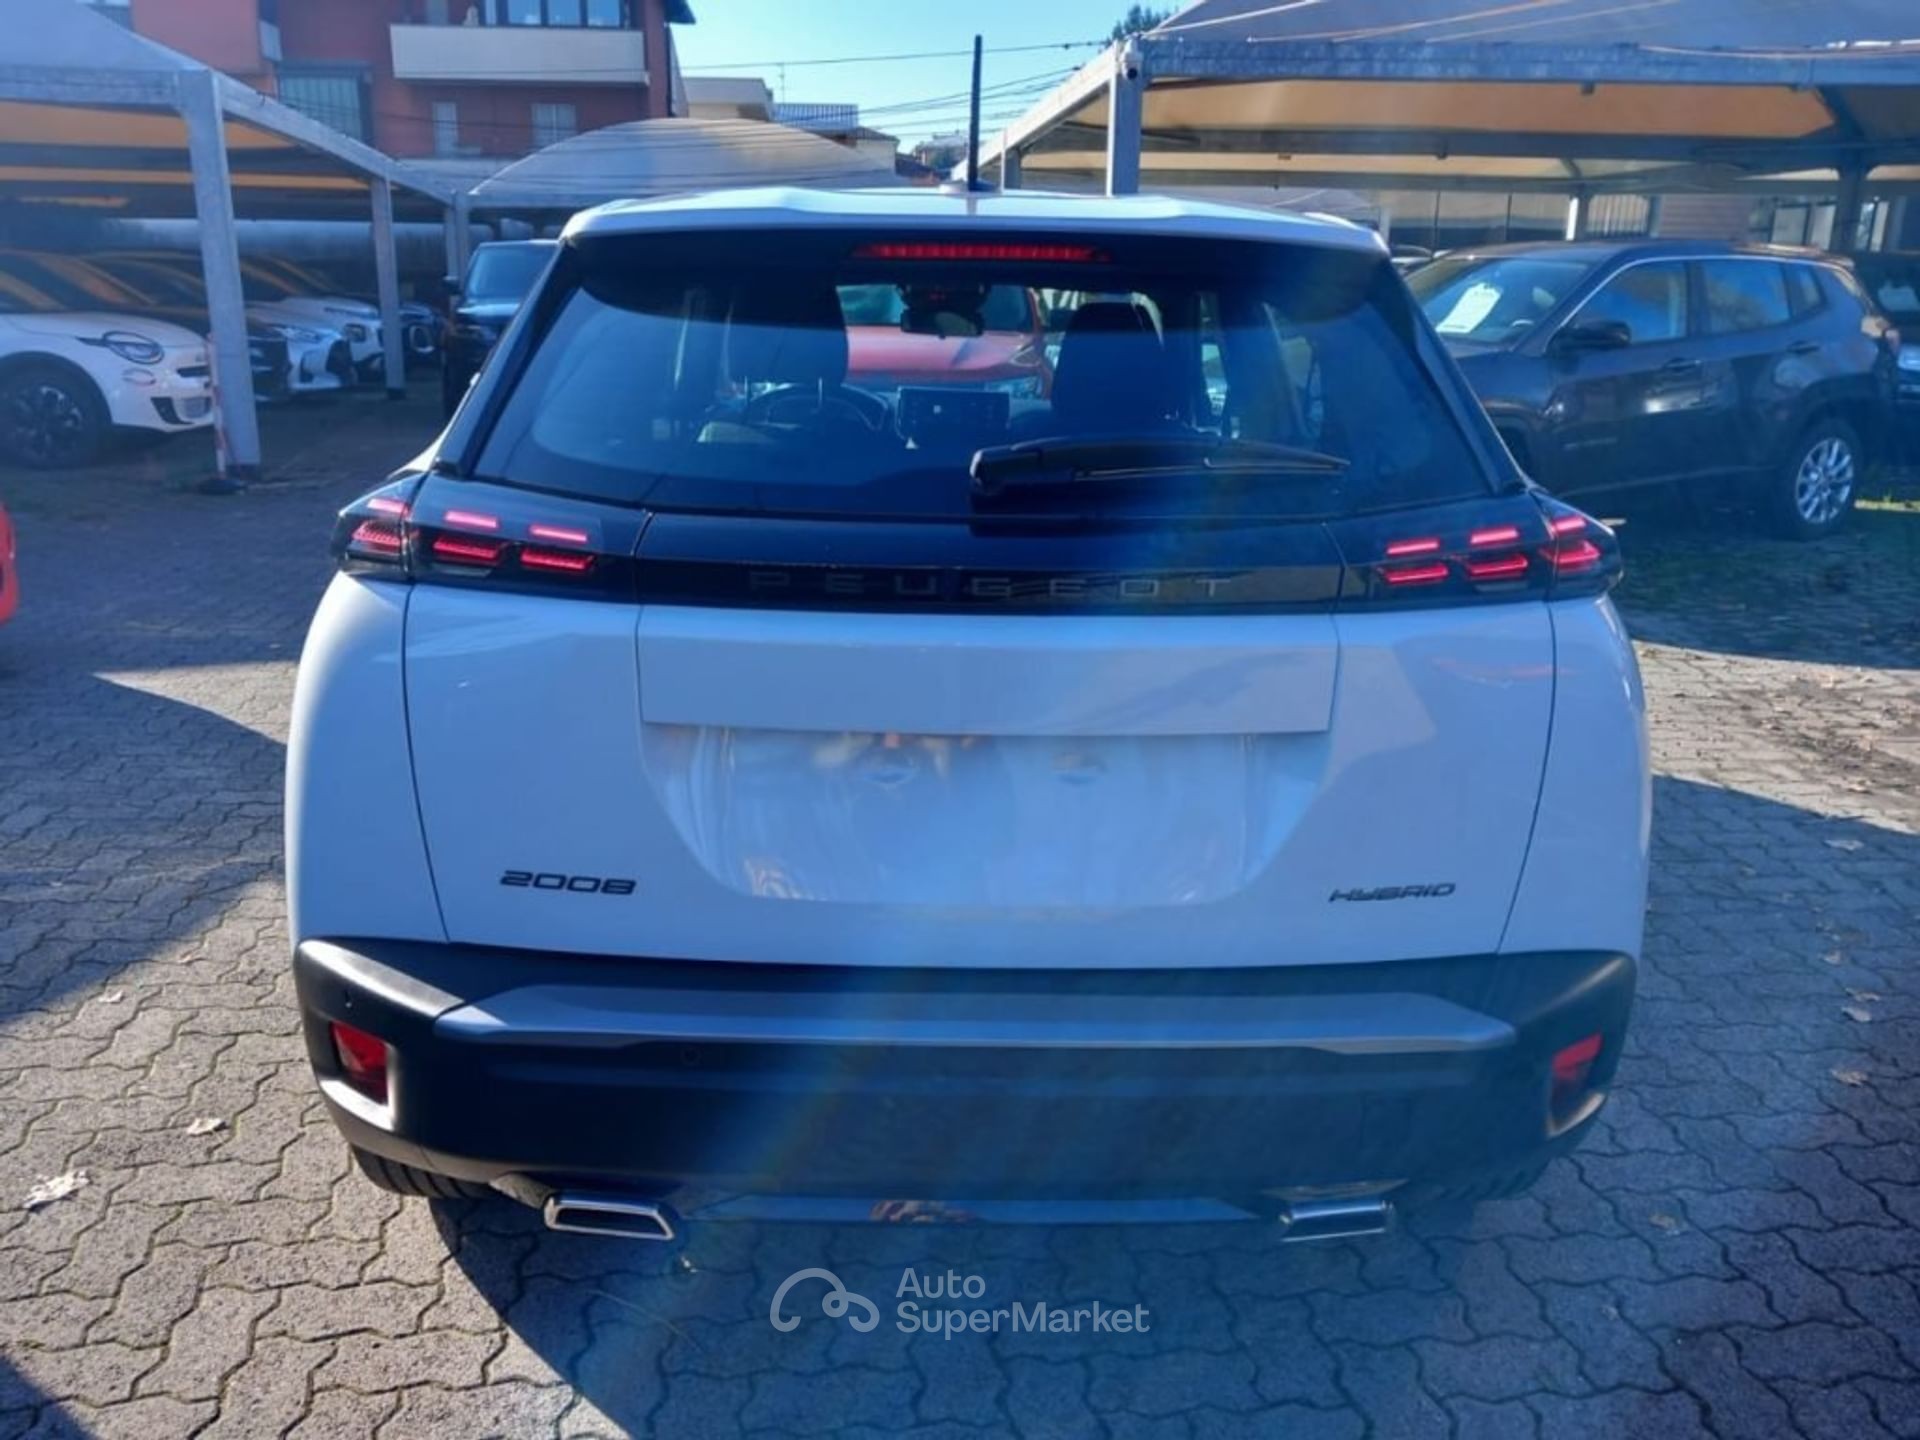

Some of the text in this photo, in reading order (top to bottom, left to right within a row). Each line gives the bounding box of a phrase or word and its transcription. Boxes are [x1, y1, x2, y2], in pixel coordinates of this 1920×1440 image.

[748, 570, 1231, 597] PEUGEOT
[500, 869, 636, 896] 2008
[1328, 882, 1456, 903] HYBRID
